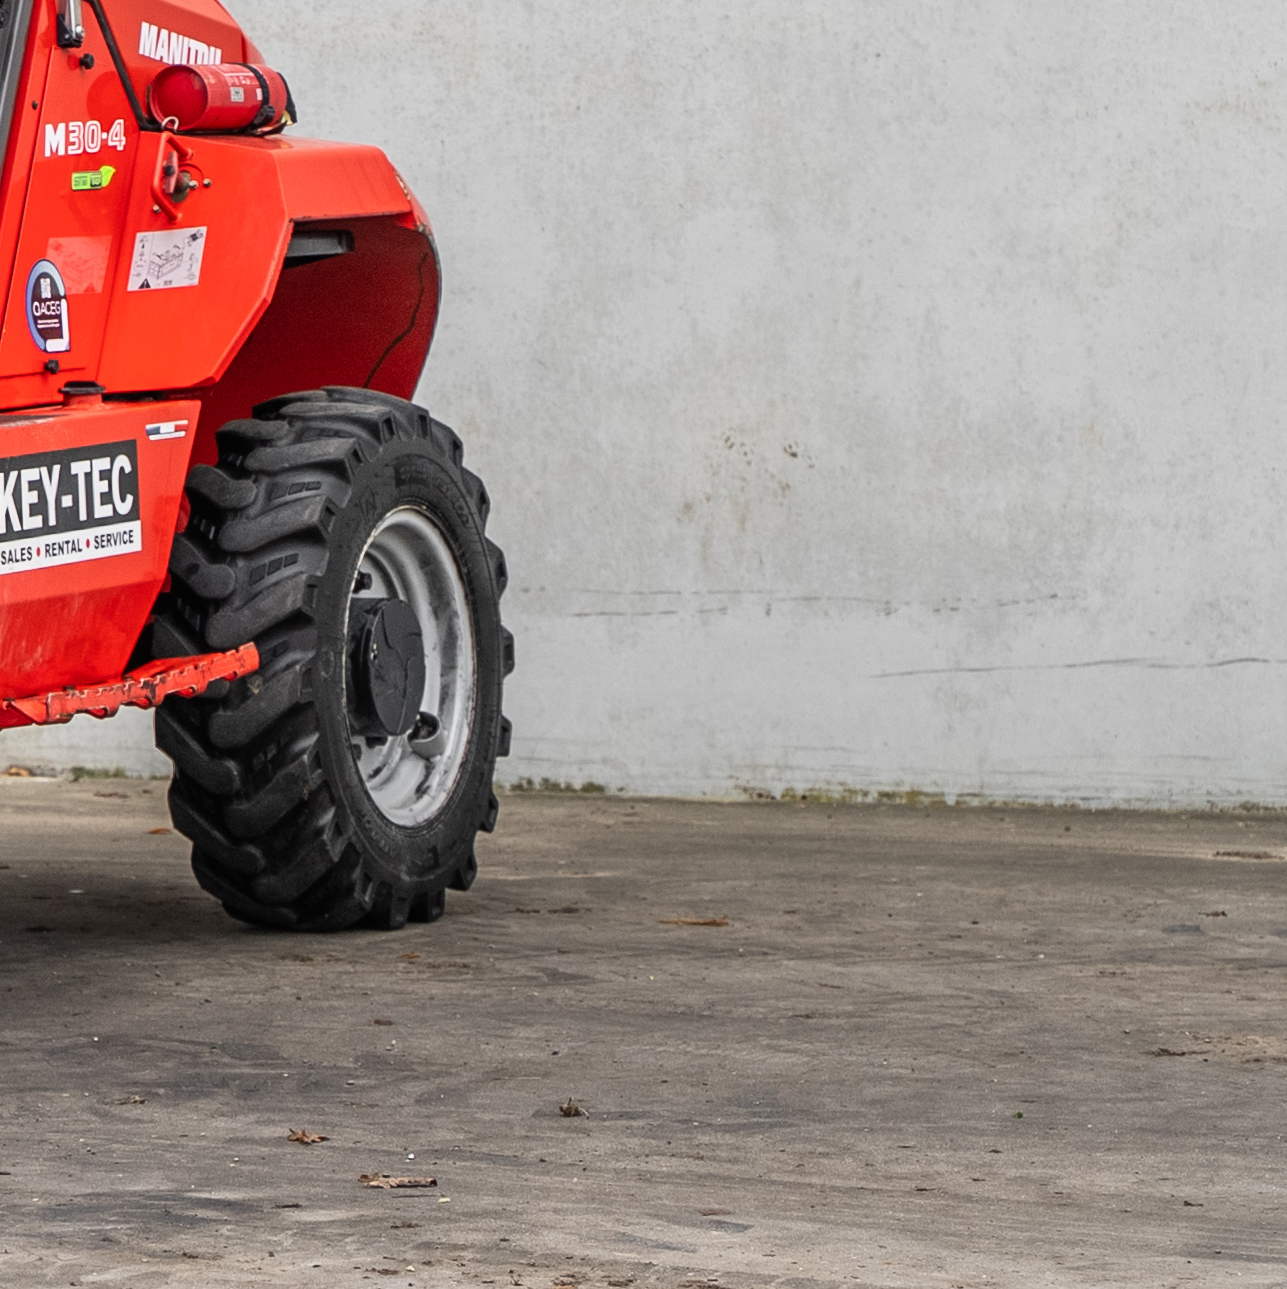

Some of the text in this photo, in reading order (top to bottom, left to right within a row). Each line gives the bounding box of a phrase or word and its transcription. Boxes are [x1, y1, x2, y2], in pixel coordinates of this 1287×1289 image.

[0, 529, 134, 565] SALES RENTAL SERVICE
